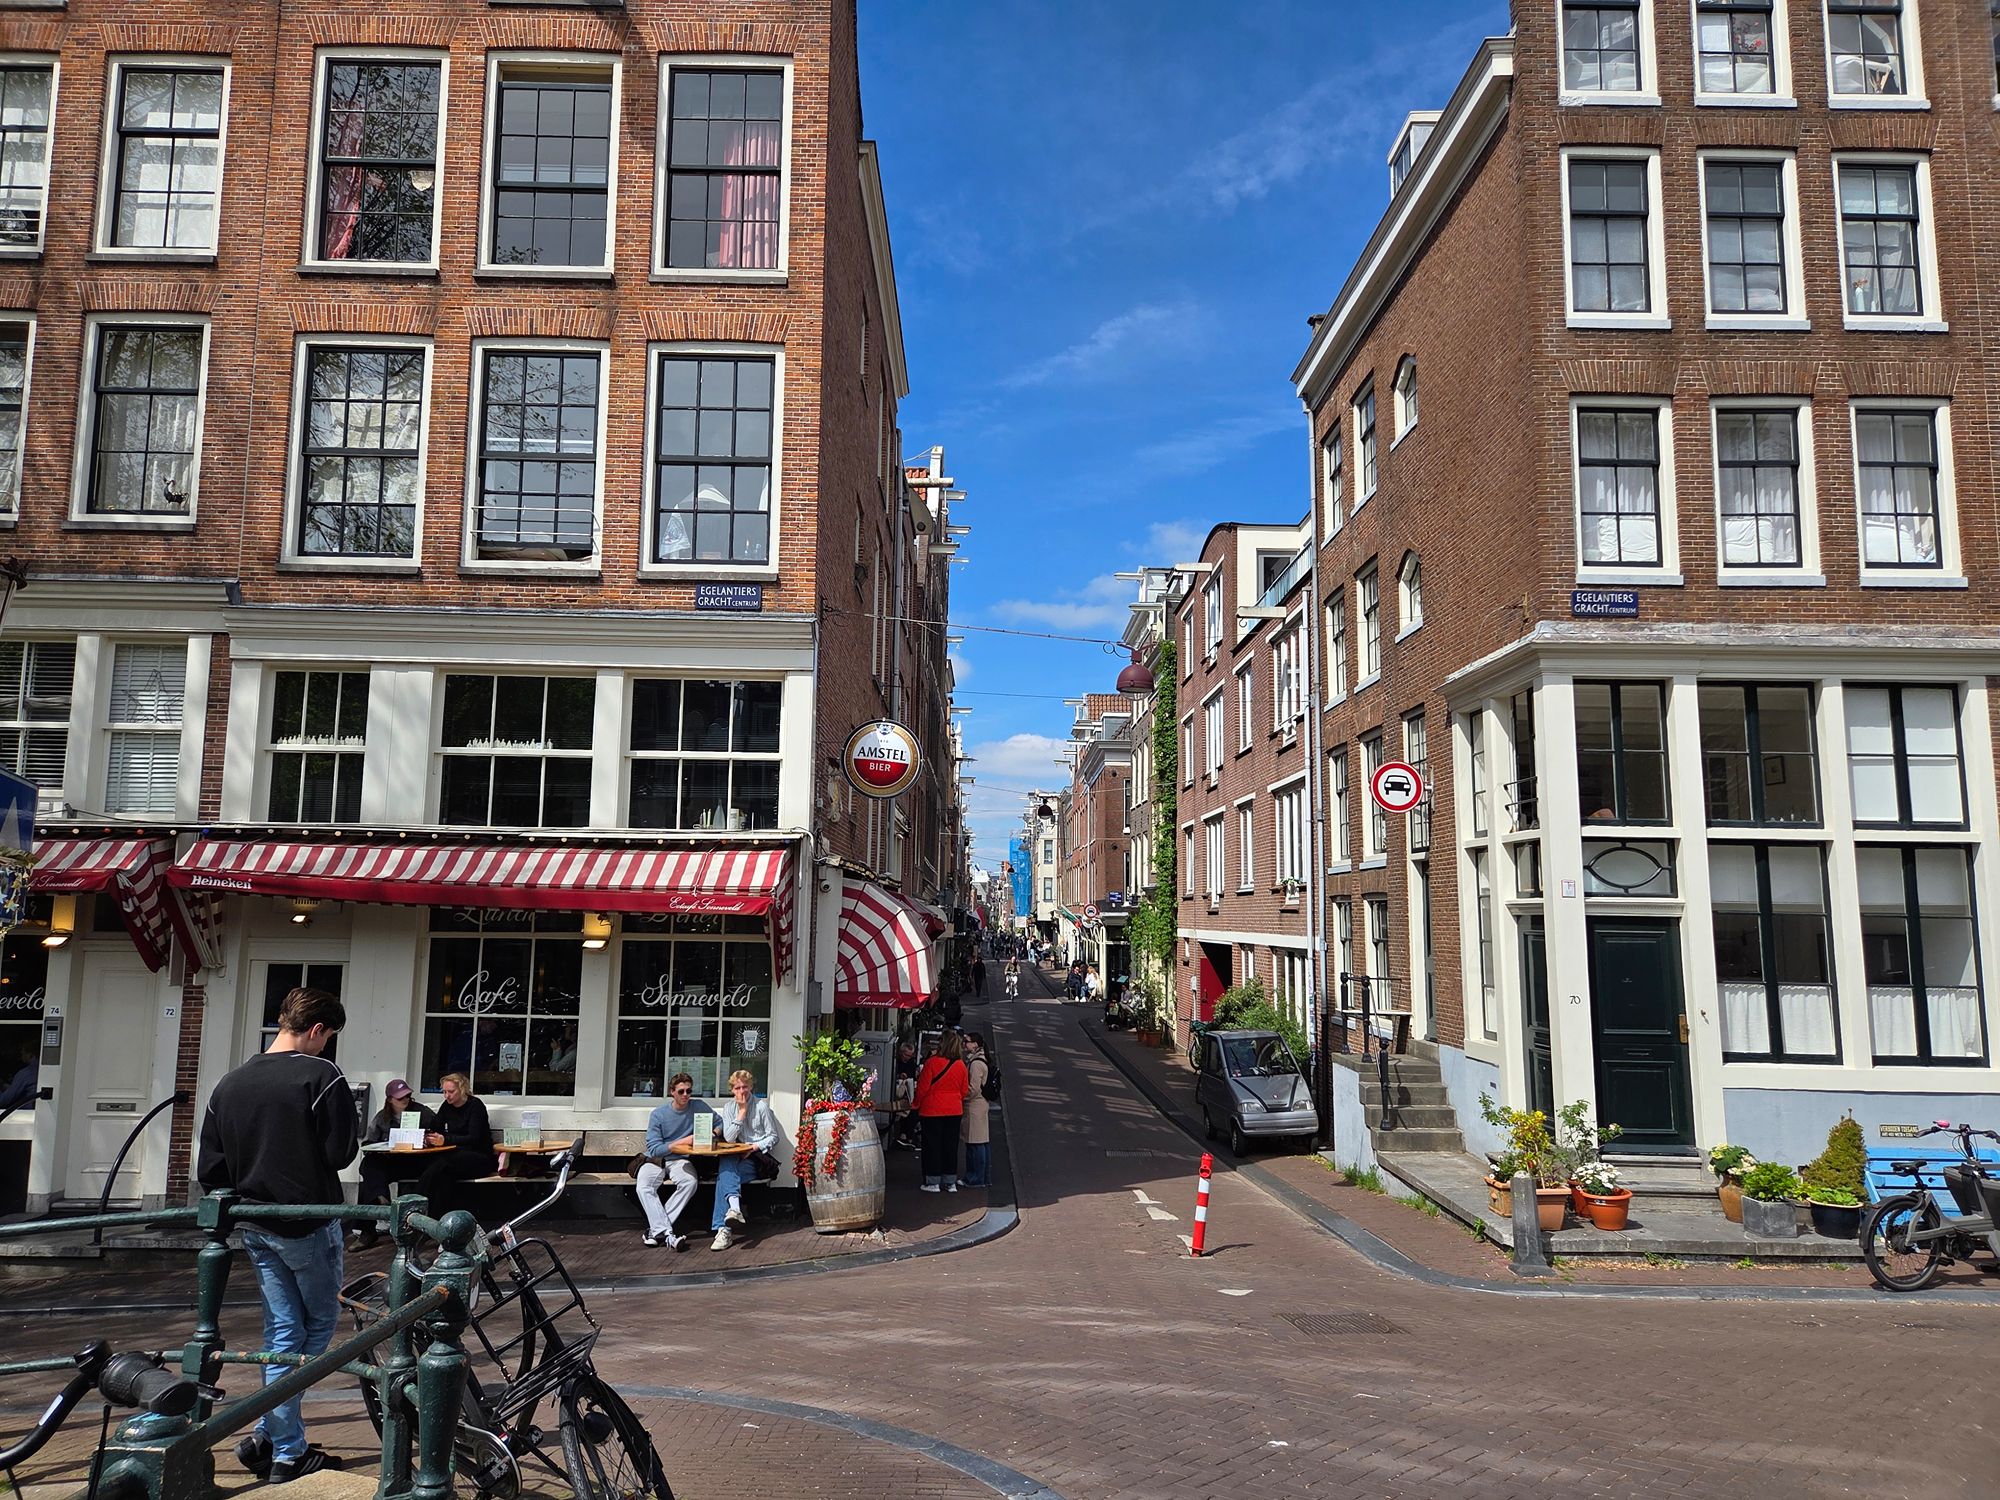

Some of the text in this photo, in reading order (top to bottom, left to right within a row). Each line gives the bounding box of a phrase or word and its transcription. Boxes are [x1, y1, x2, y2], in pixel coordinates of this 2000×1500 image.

[700, 586, 757, 596] EGELANTIERS
[697, 596, 732, 606] GRACHT
[1576, 593, 1634, 603] EGELANTIERS
[1574, 603, 1609, 613] GRACHT
[857, 746, 907, 762] AMSTEL
[869, 762, 891, 772] BIER
[190, 874, 252, 890] Heineken
[698, 898, 745, 911] Sonneveld
[457, 969, 521, 1015] Café
[641, 973, 758, 1007] Sonneveld
[1569, 995, 1581, 1005] 70
[50, 1007, 60, 1015] 74
[165, 1008, 175, 1016] 72
